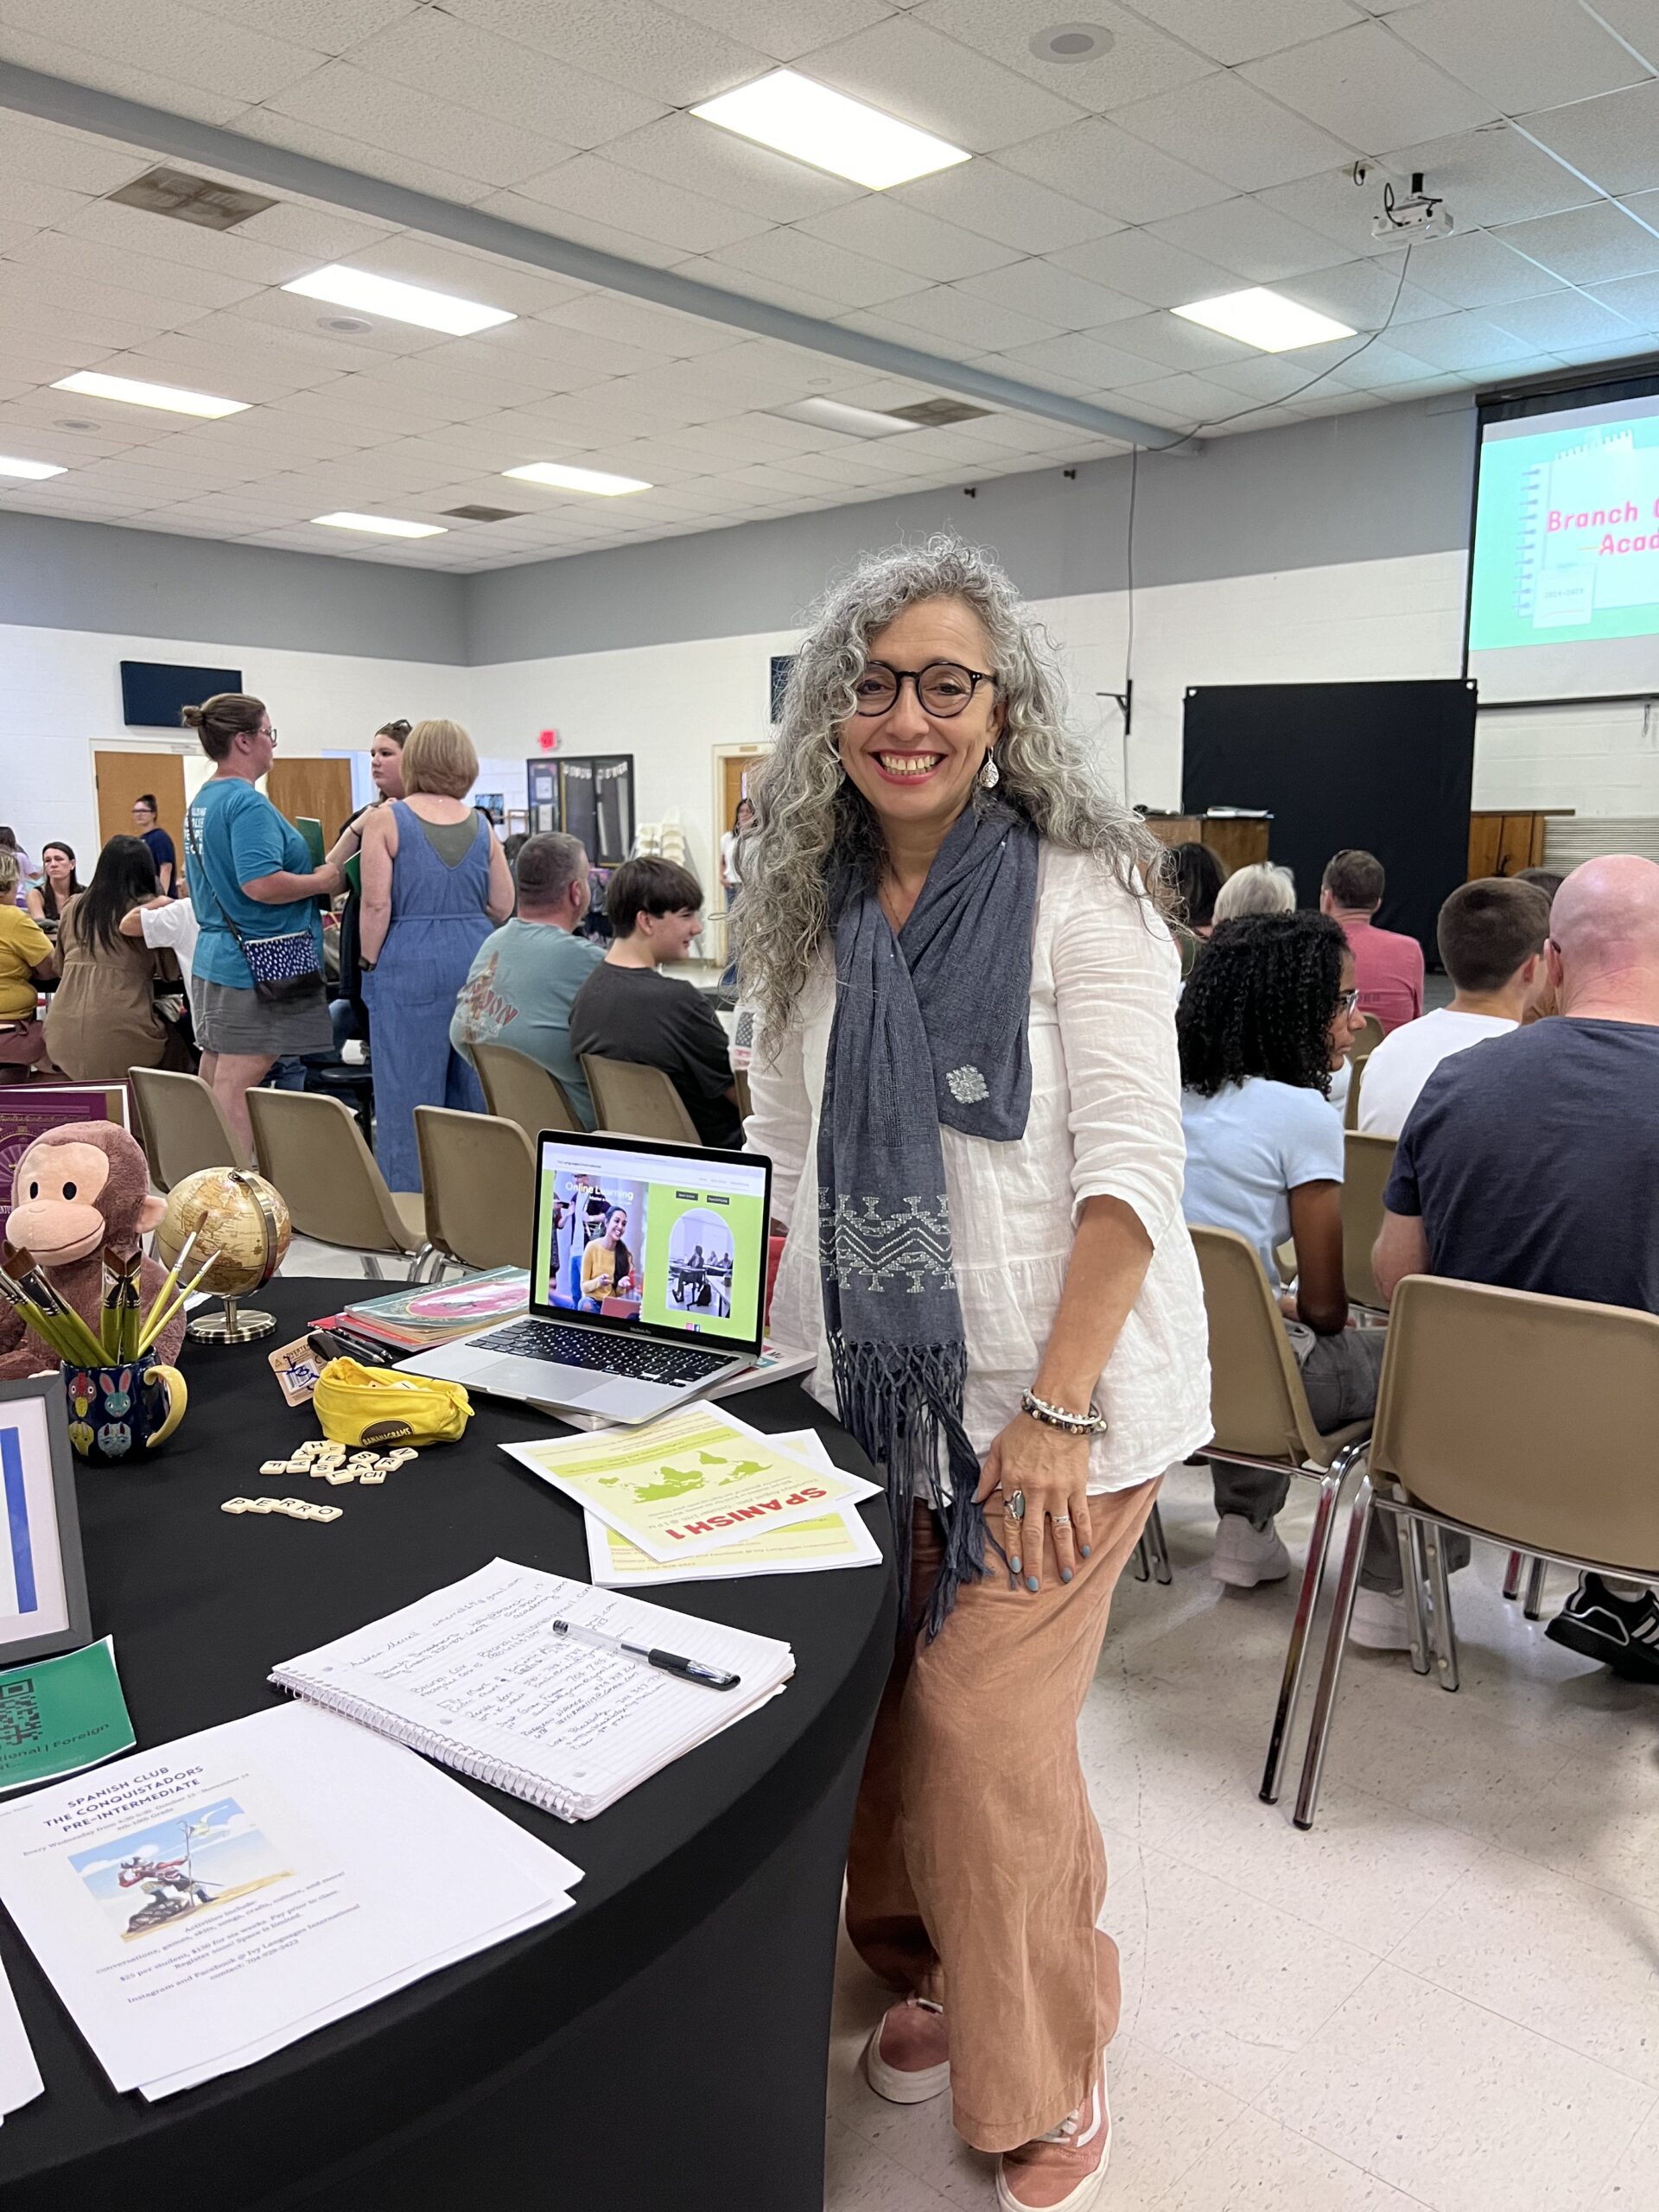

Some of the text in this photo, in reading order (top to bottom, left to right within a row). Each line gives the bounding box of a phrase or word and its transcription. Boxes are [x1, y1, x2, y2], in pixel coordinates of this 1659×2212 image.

[1547, 501, 1638, 533] Branch
[565, 1181, 594, 1194] Online
[362, 1427, 411, 1446] BANANAGRAMS
[229, 1499, 334, 1515] PERRO
[691, 1486, 828, 1535] SPANISH
[665, 1528, 686, 1541] 1
[54, 1723, 110, 1747] Foreign
[43, 1764, 203, 1828] THE CONQUISTADORS
[67, 1765, 169, 1808] SPANISH CLUB
[62, 1777, 200, 1833] PRE-INTERMEDIATE
[183, 1913, 224, 1933] Activities
[173, 1950, 210, 1970] Register
[137, 1966, 154, 1977] per
[126, 1981, 175, 2005] Instagram
[175, 1974, 194, 1986] and
